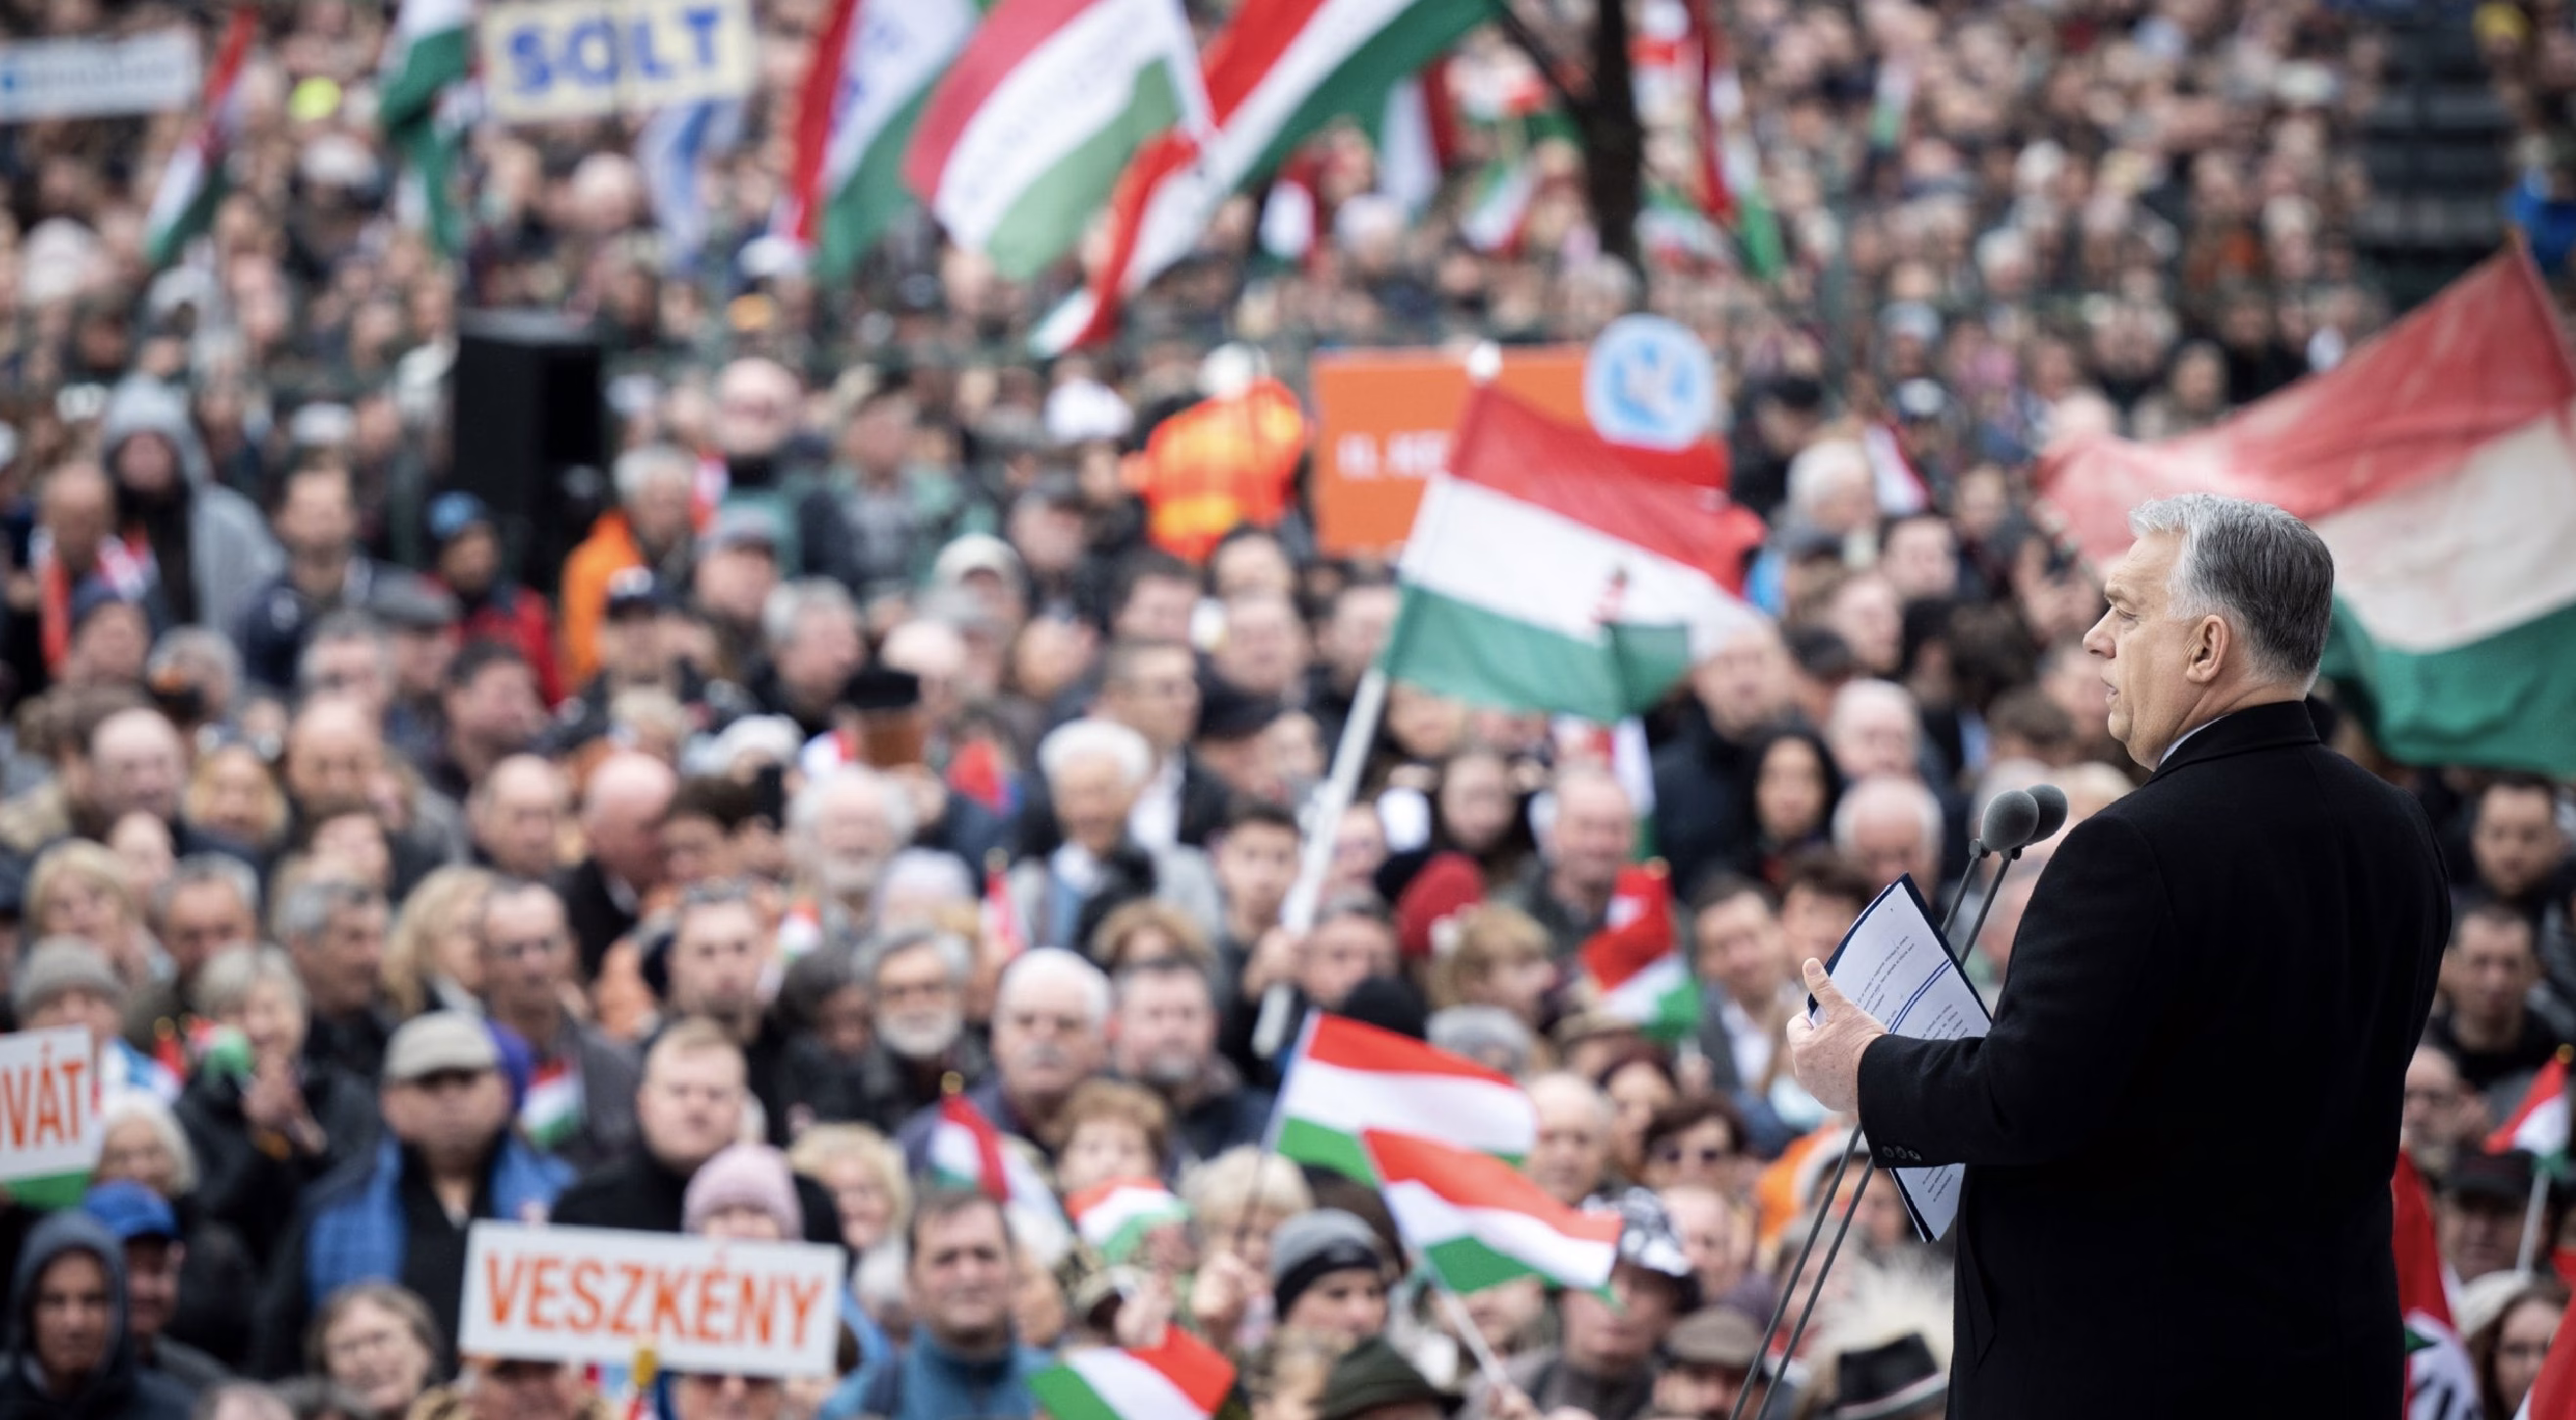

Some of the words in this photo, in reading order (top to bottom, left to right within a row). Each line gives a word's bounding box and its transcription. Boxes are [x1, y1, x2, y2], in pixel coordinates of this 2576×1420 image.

[506, 7, 720, 95] SOLT
[0, 1039, 85, 1149] VÁT
[485, 1240, 825, 1349] VESZKÉNY
